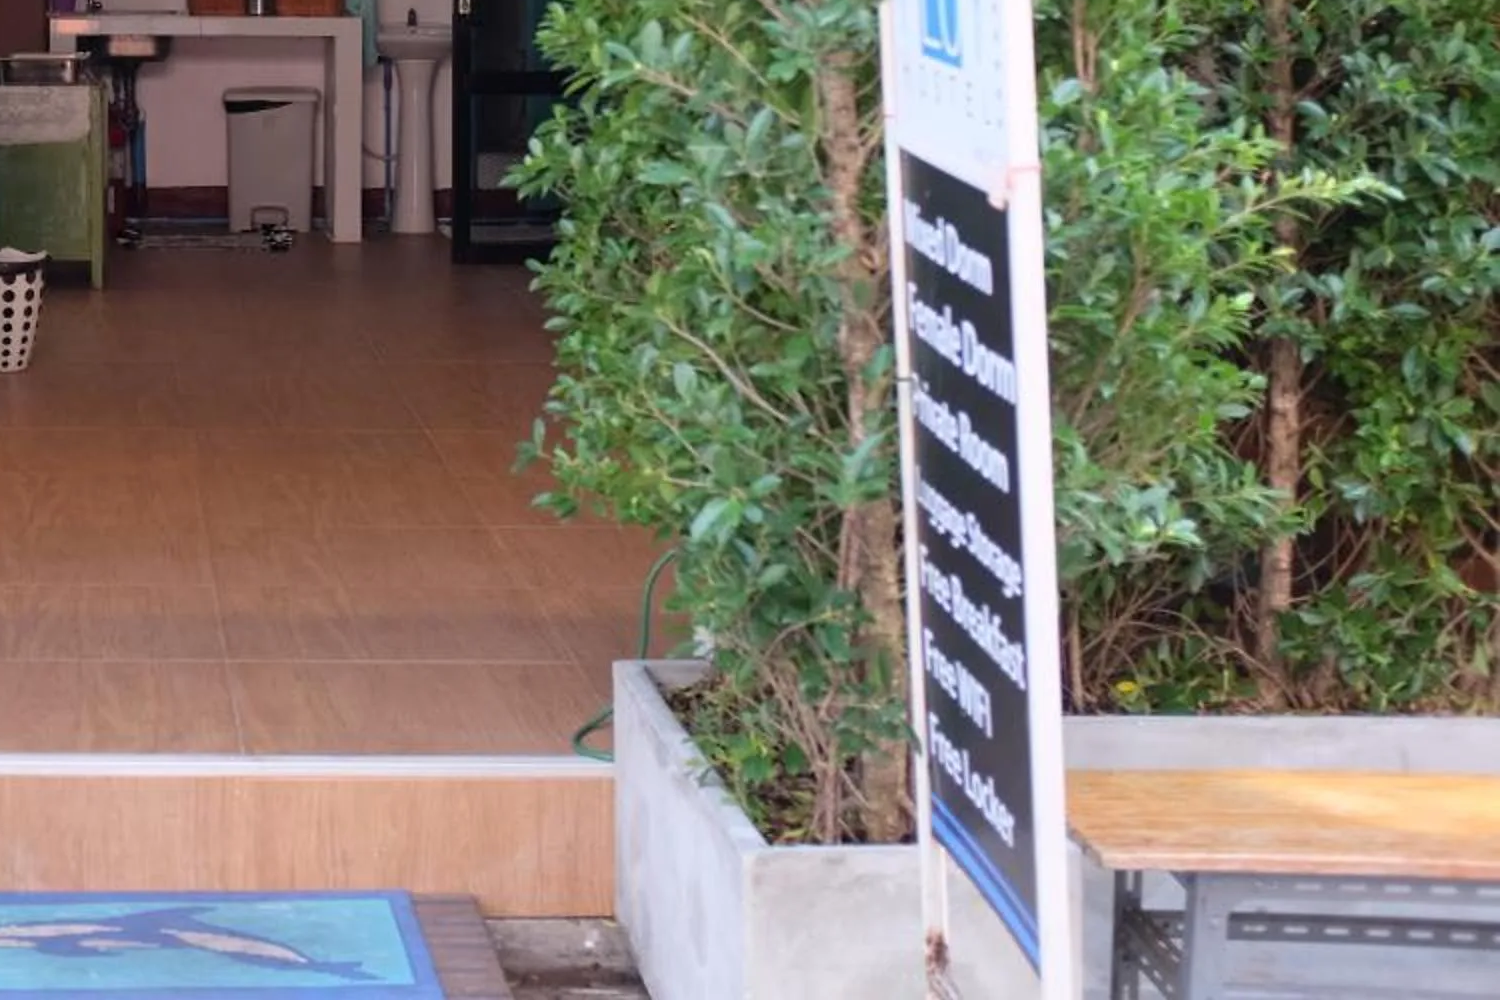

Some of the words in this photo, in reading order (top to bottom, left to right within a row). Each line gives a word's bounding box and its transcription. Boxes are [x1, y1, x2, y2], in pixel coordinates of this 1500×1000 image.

[945, 222, 992, 295] Dorm
[907, 282, 961, 367] Female
[961, 320, 1016, 405] Dorm
[910, 372, 958, 452] Private
[958, 411, 1009, 493] Room
[966, 512, 1021, 598] Storage
[920, 544, 951, 612] Free
[950, 575, 1025, 690] Breakfast
[923, 628, 957, 699] Free
[928, 711, 962, 785] Free
[963, 749, 1015, 847] Locker
